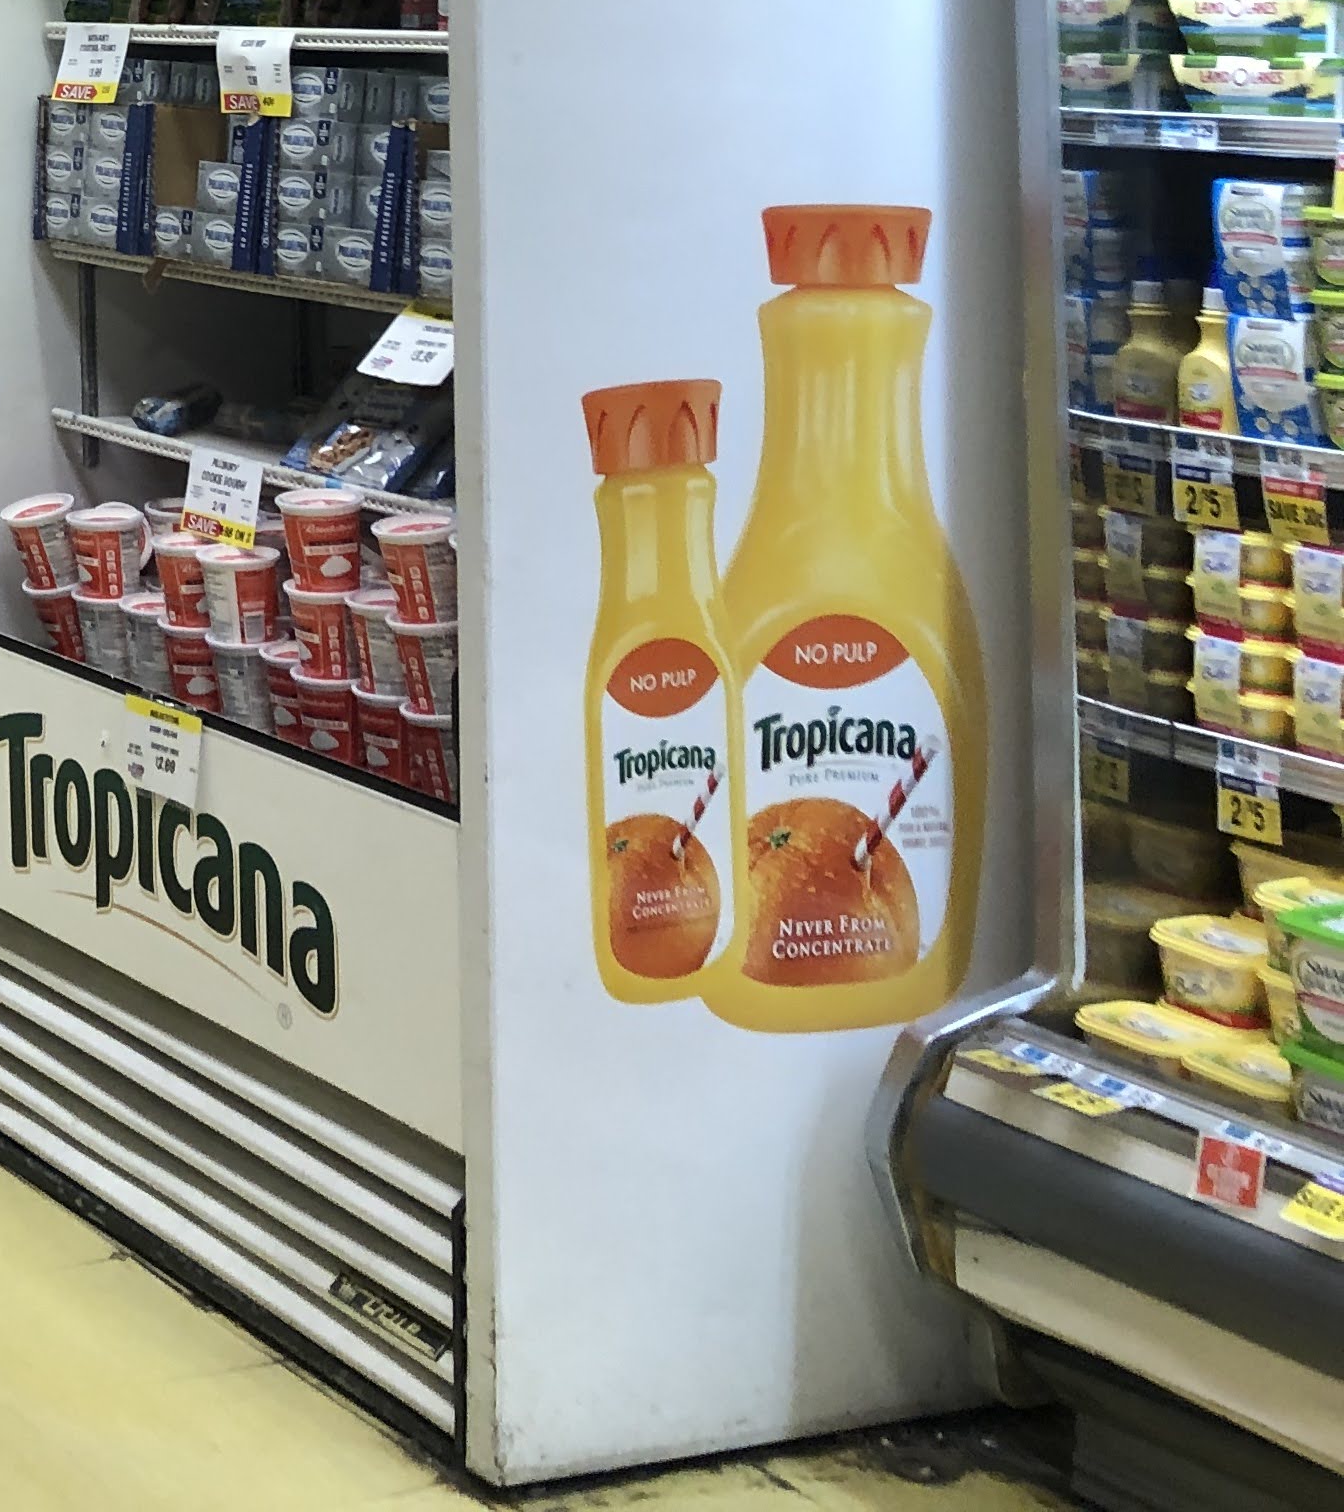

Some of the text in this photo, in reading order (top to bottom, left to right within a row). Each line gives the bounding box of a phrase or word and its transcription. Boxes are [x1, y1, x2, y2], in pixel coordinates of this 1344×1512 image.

[60, 86, 93, 100] SAVE
[228, 96, 258, 110] SAVE
[187, 514, 218, 536] SAVE
[795, 641, 879, 665] NO PULP
[630, 669, 697, 693] NO PULP
[753, 705, 916, 772] Tropicana
[614, 739, 715, 786] Tropicana
[636, 892, 671, 905] NEVER
[779, 915, 886, 938] NEVER FROM
[772, 937, 891, 960] CONCENTRATE
